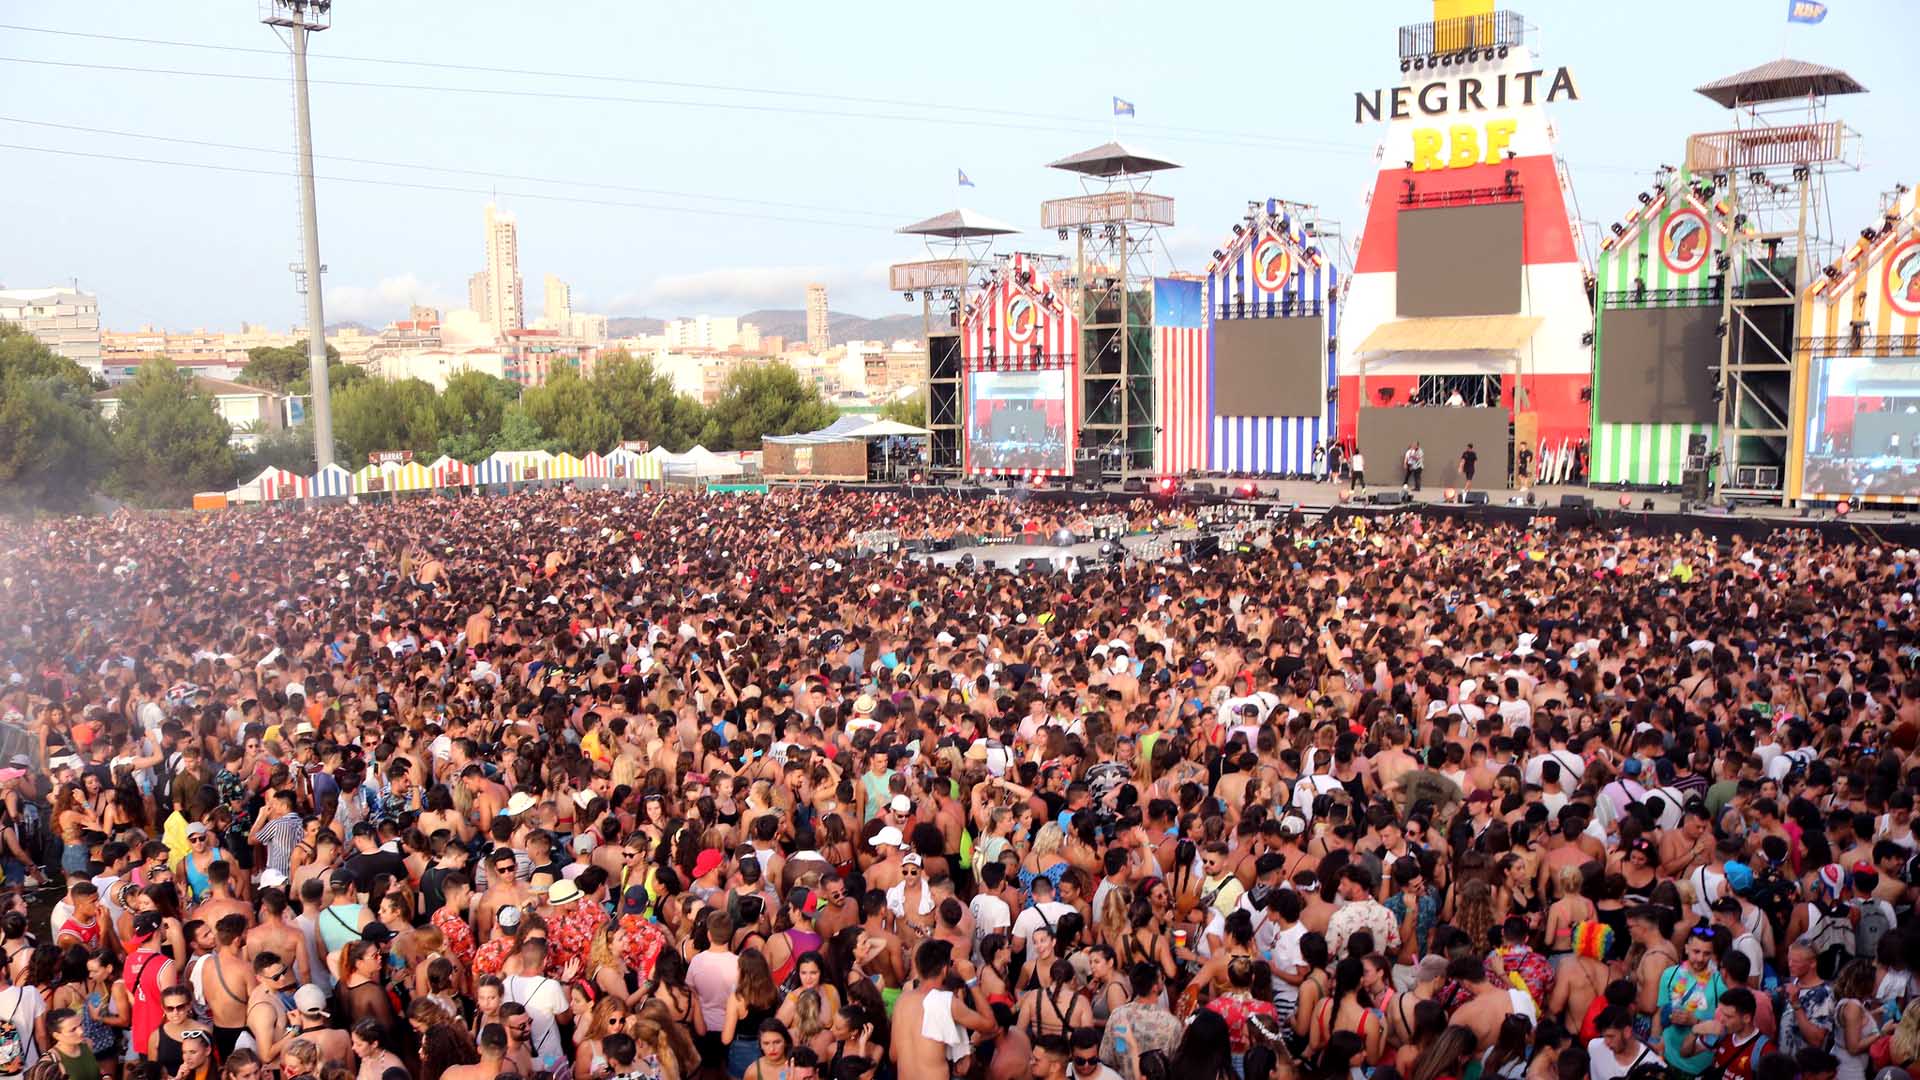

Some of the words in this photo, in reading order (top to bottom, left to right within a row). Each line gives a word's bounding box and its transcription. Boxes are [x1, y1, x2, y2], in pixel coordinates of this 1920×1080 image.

[1354, 66, 1579, 123] NEGRITA
[1411, 119, 1518, 172] RBF
[380, 451, 403, 461] BARRAS
